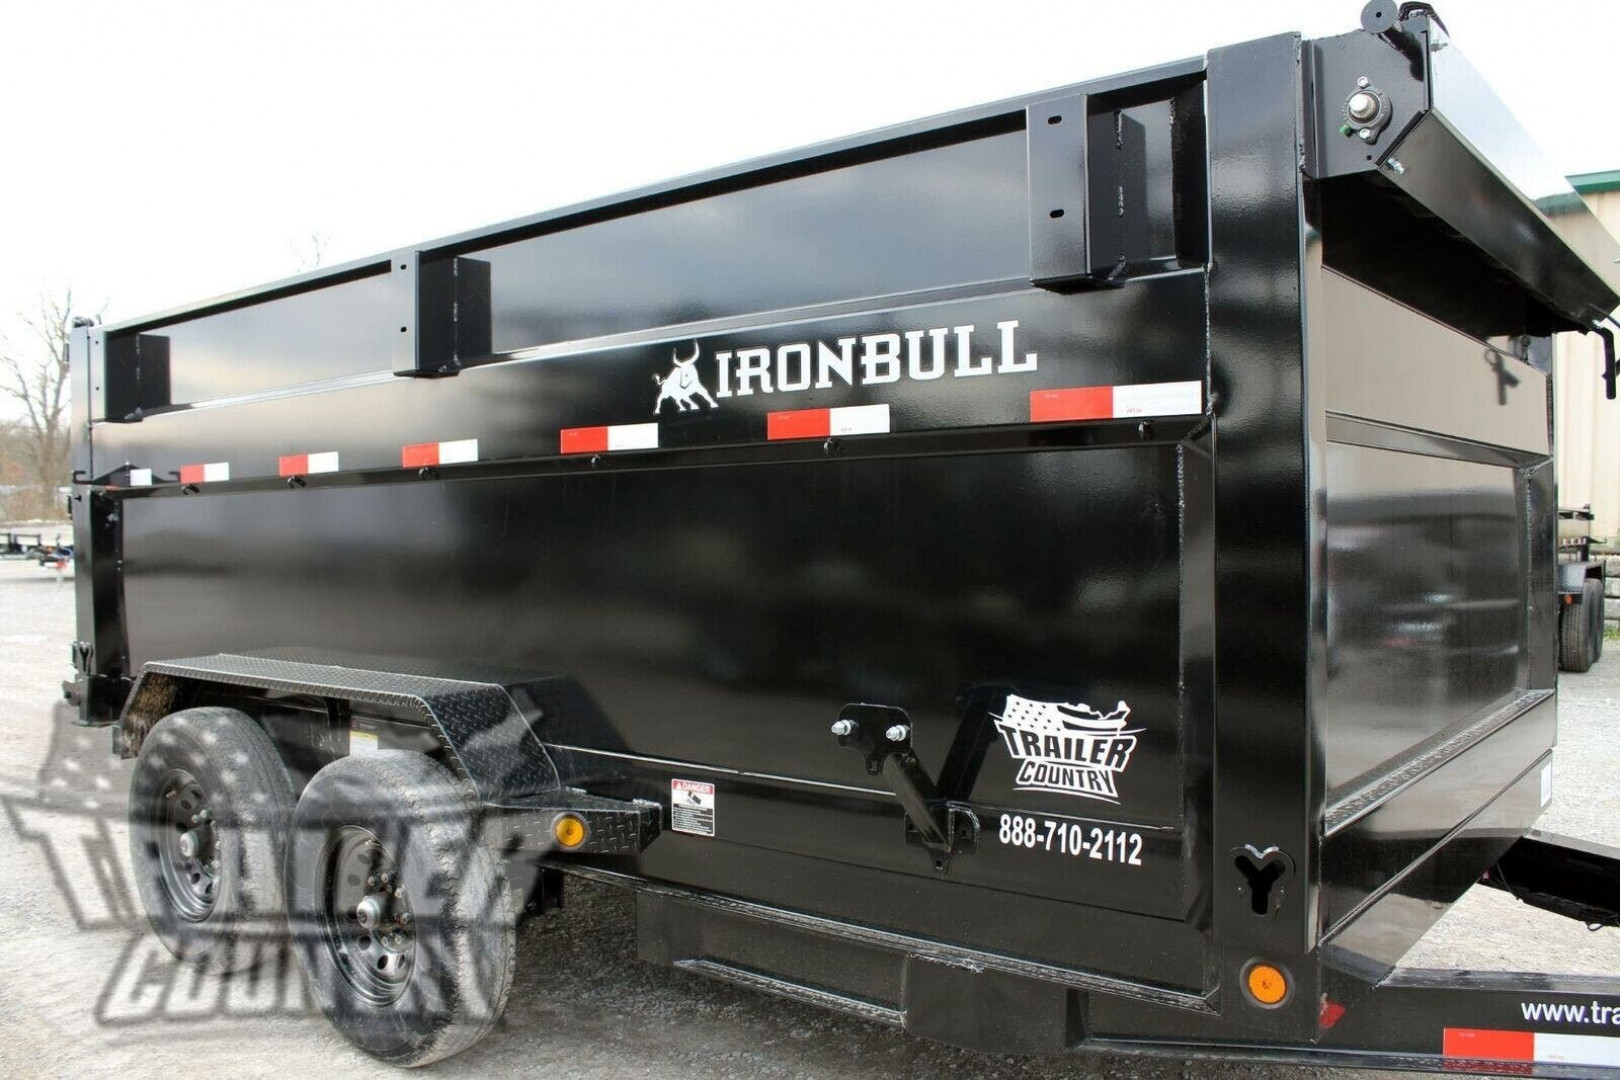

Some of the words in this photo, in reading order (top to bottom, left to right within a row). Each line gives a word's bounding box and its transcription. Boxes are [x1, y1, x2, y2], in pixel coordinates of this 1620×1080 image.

[715, 320, 1037, 398] IRONBULL
[997, 722, 1136, 771] TRAILER
[1017, 760, 1115, 795] COUNTRY
[999, 813, 1142, 866] 888-710-2112
